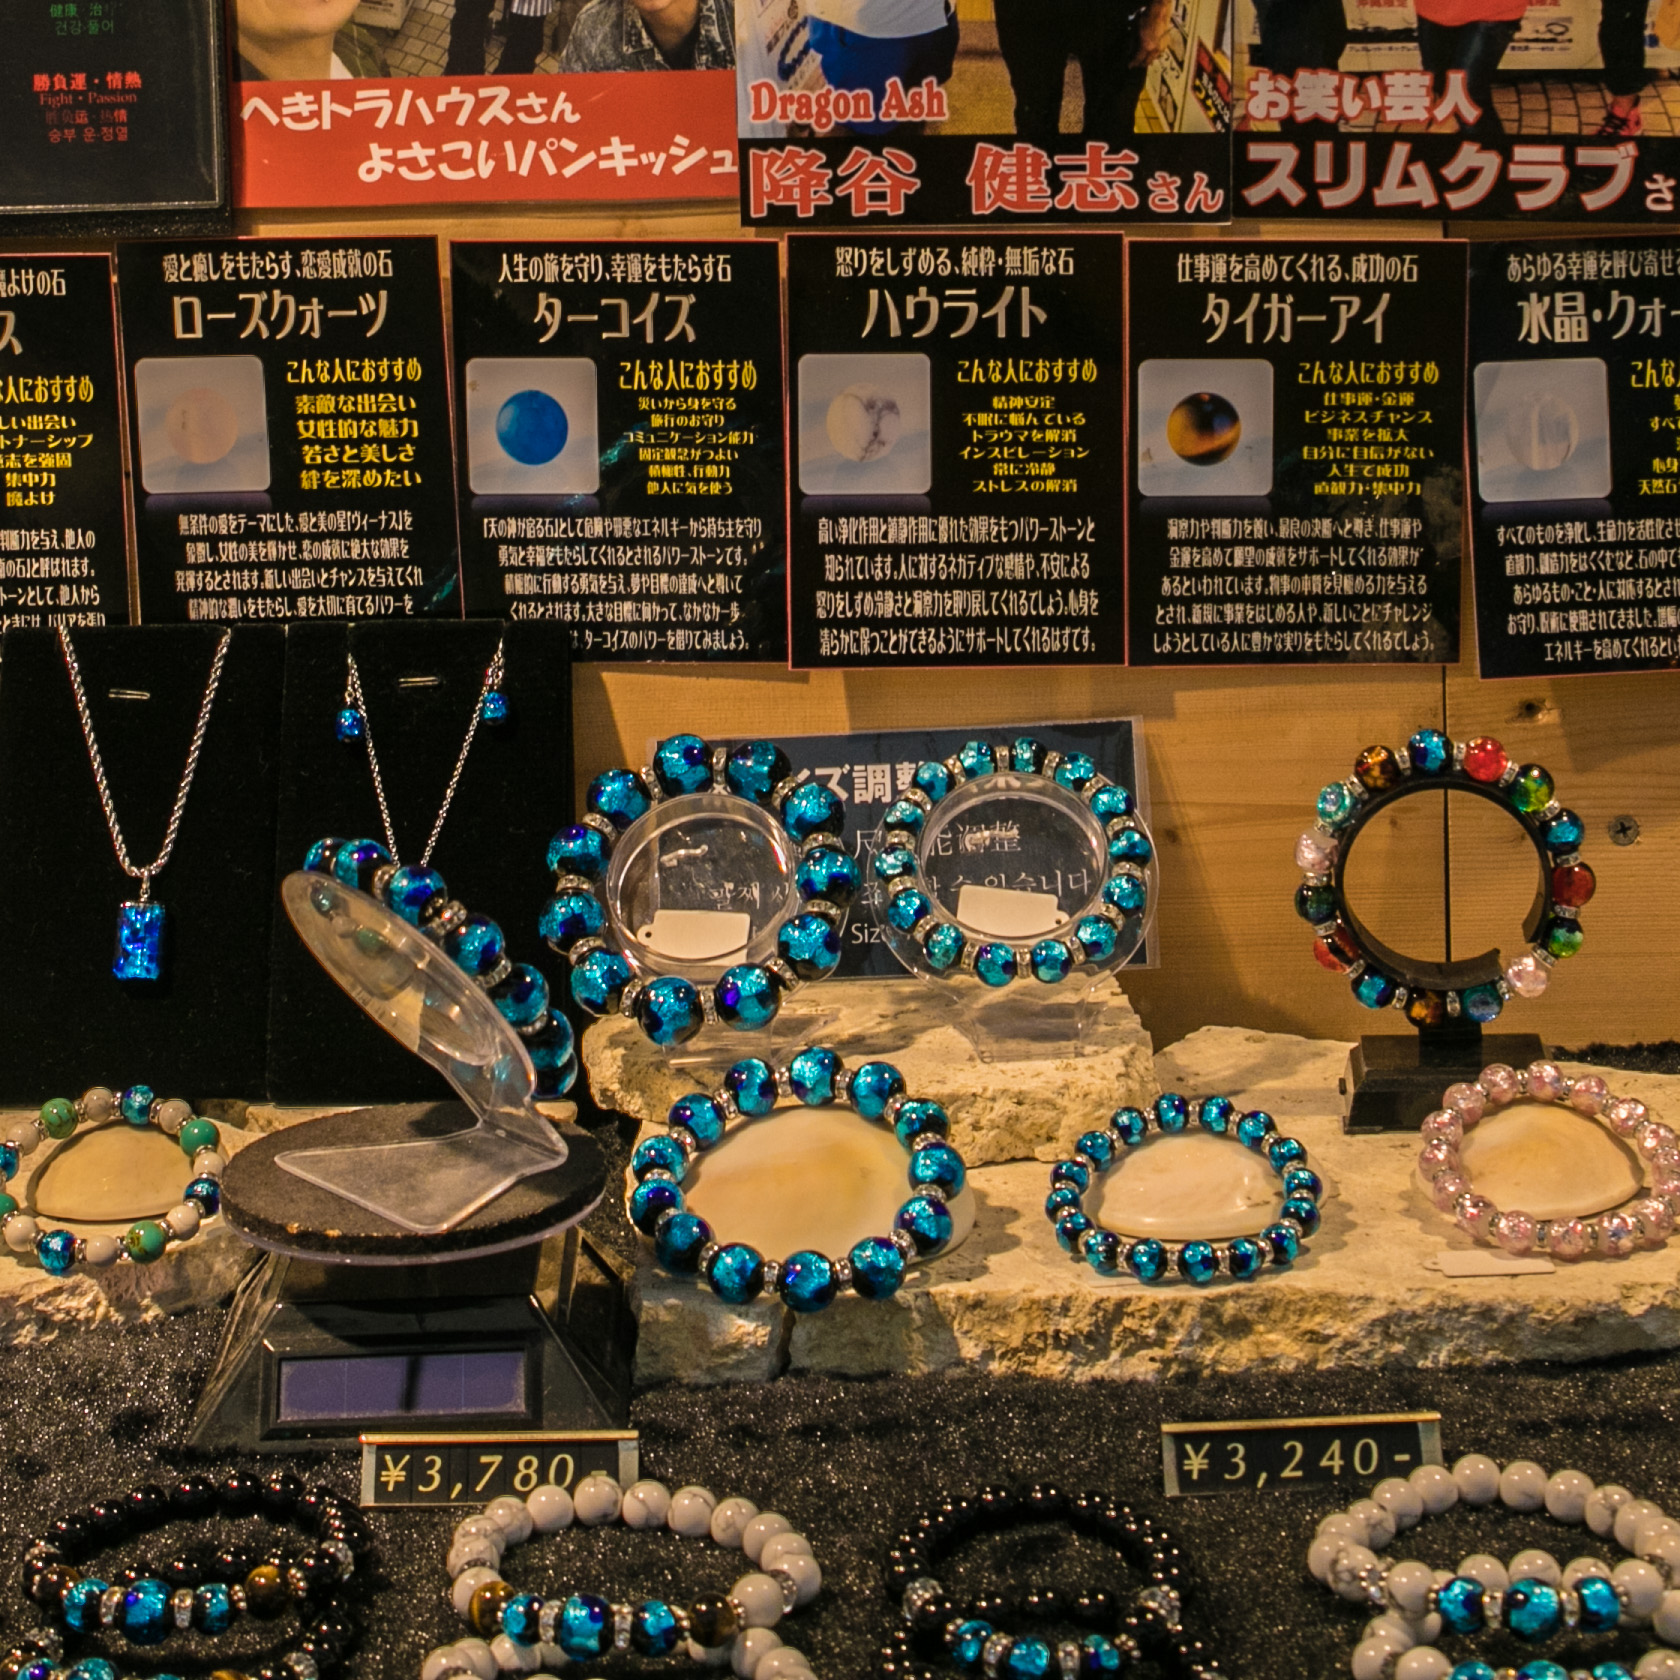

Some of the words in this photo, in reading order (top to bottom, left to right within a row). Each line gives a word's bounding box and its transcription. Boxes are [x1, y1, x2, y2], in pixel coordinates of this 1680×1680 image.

[33, 72, 141, 91] 勝負運・情熱
[1247, 69, 1481, 123] お笑い芸人
[240, 86, 581, 131] へきトラハウスさん
[748, 79, 875, 132] Dragon
[879, 76, 949, 121] Ash
[749, 145, 921, 218] 降谷
[965, 140, 1224, 214] 健志さん
[163, 249, 393, 283] 愛と癒しをもたらす、恋愛成就の石
[498, 253, 732, 283] 人生の旅を守り、幸運をもたらす石
[1178, 253, 1418, 283] 仕事運を高めてくれる、成功の石
[173, 289, 388, 340] ローズクォーツ
[533, 292, 696, 344] ターコイズ
[861, 285, 1047, 338] ハウライト
[1202, 292, 1390, 344] タイガーアイ
[287, 357, 422, 384] こんな人におすすめ
[619, 359, 757, 390] こんな人におすすめ
[957, 358, 1097, 383] こんな人におすすめ
[1298, 361, 1439, 384] こんな人におすすめ
[295, 393, 417, 414] 素敵な出会い
[297, 418, 419, 439] 女性的な魅力
[302, 443, 416, 464] 若さと美しさ
[301, 470, 422, 489] 絆を深めたい
[380, 1453, 607, 1499] ¥3,780-
[1184, 1439, 1410, 1489] ¥3,240-
